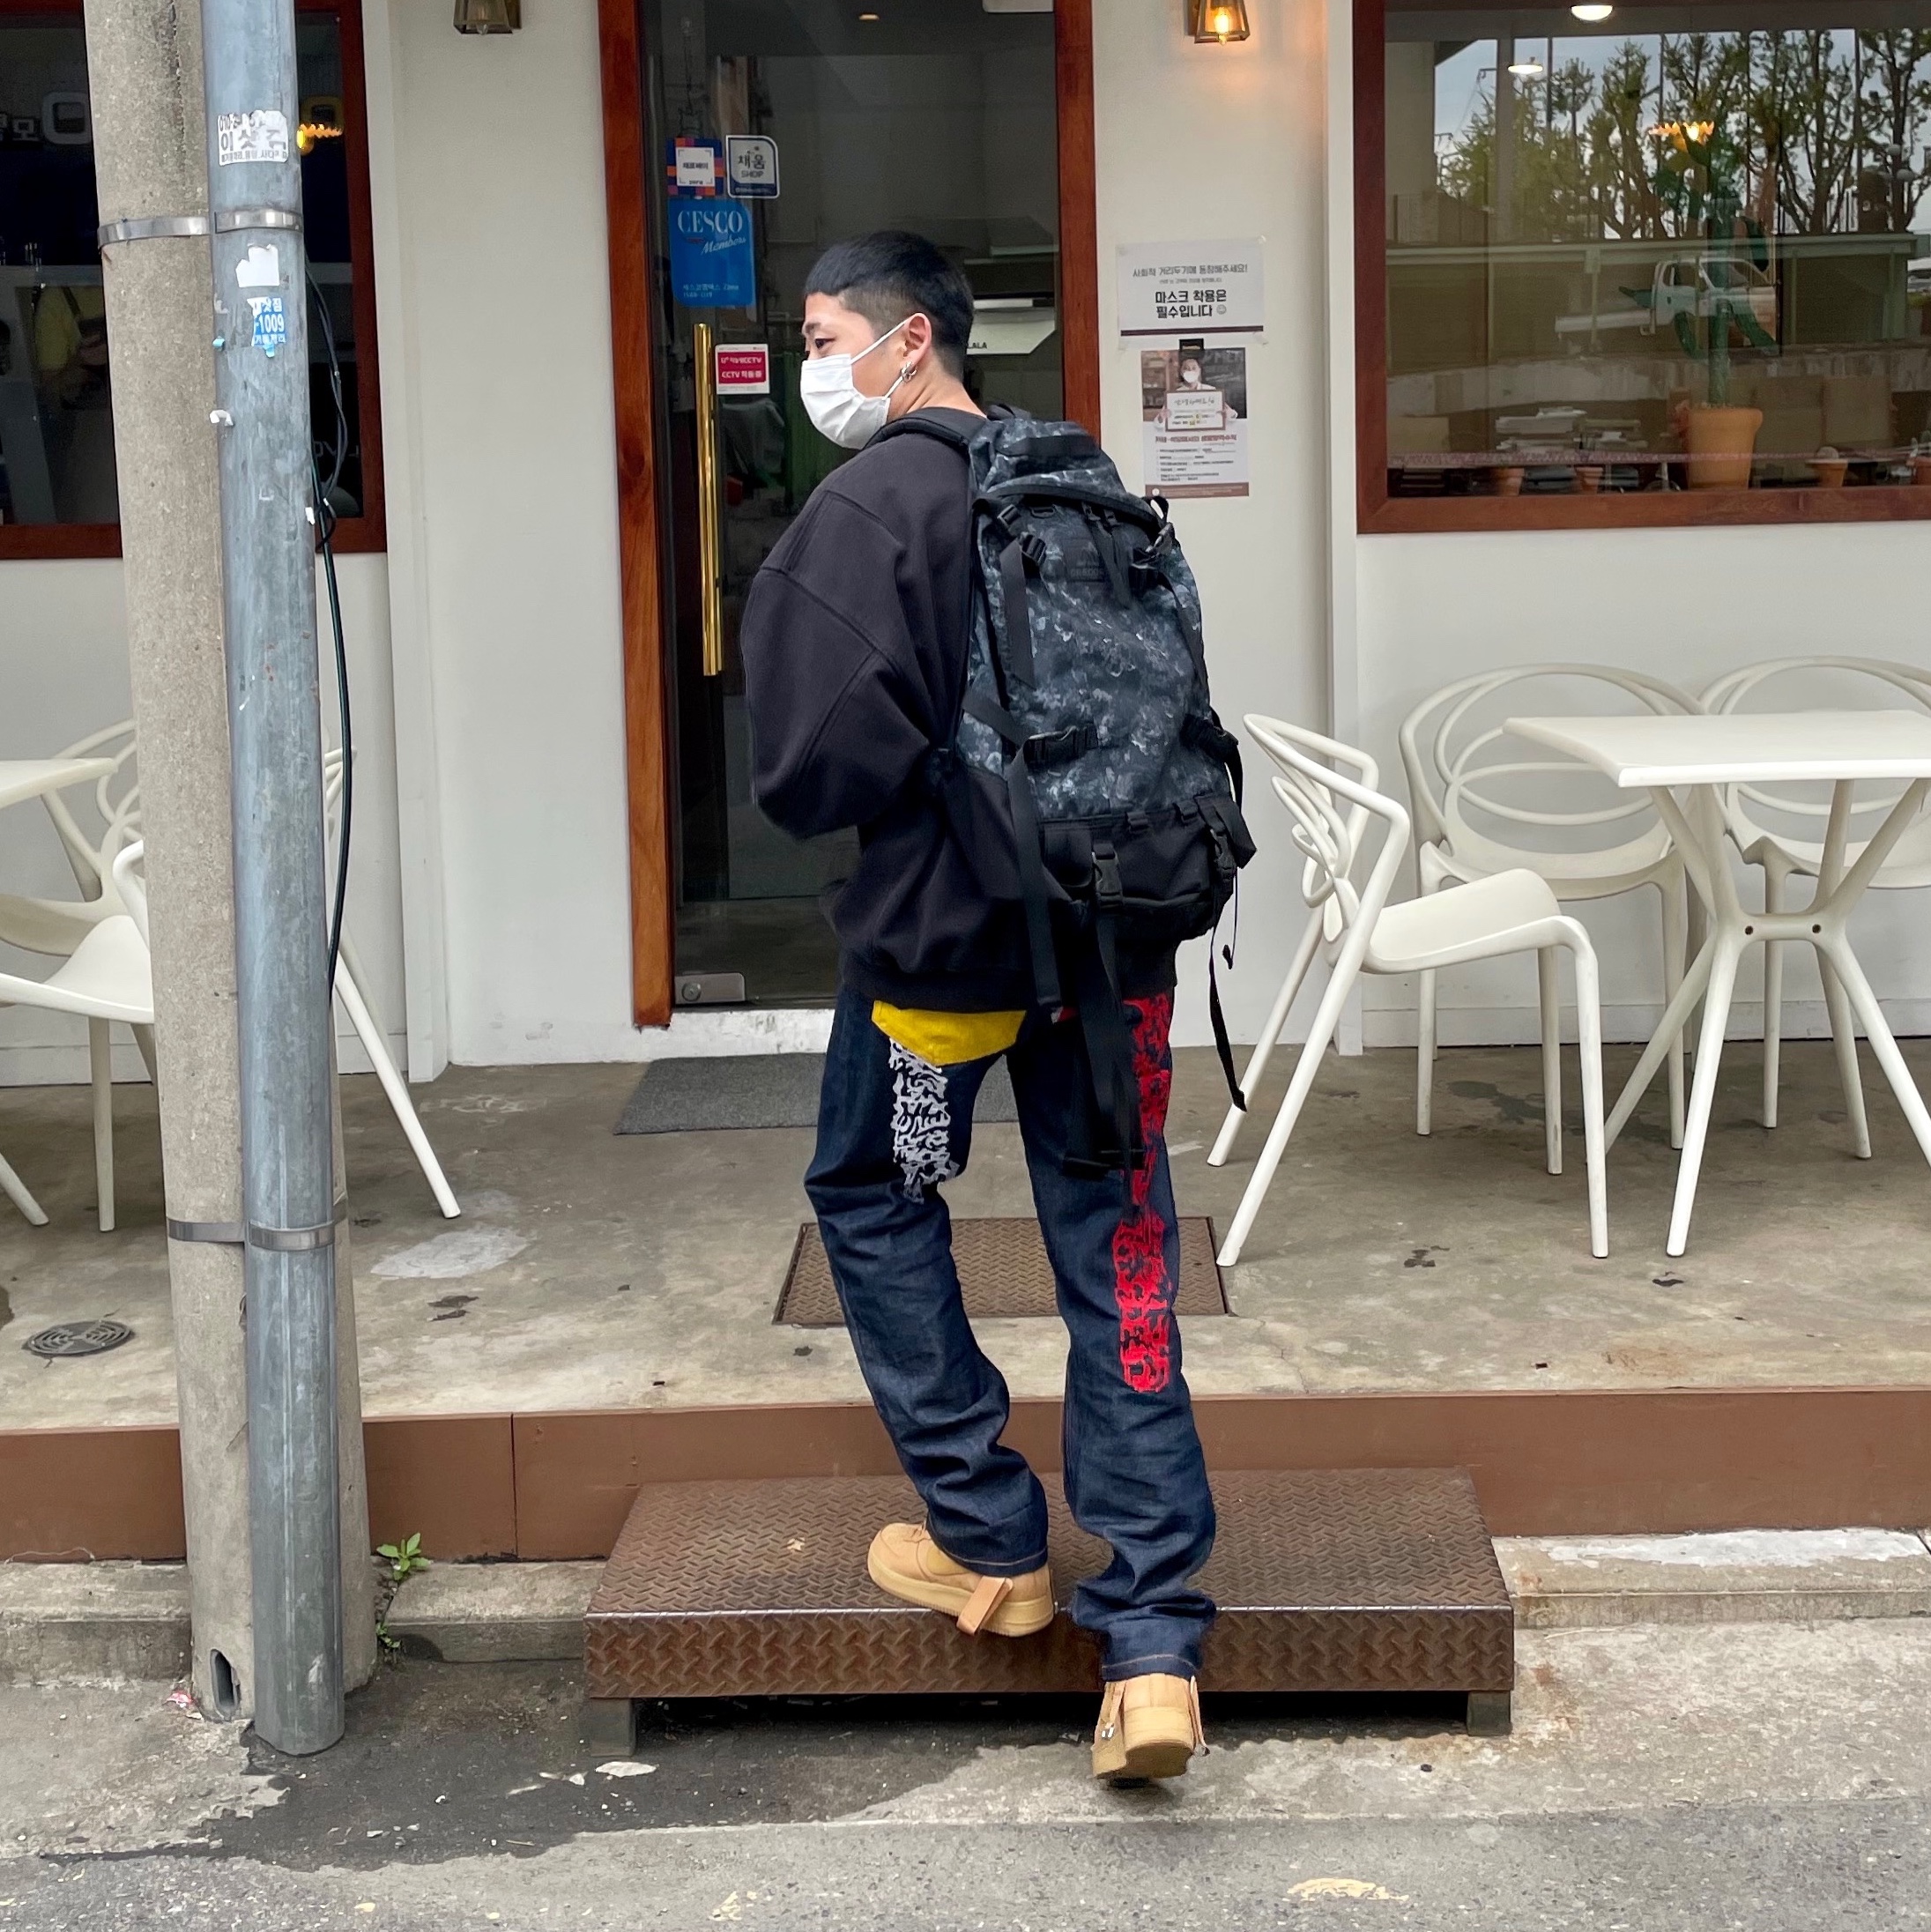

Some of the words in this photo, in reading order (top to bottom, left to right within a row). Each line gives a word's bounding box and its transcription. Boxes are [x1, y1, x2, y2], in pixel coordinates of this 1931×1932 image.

[677, 210, 743, 234] CESCO
[701, 234, 746, 255] Members
[1155, 290, 1189, 304] 마스크
[1192, 289, 1227, 303] 착용은
[1156, 305, 1213, 319] 필수입니다
